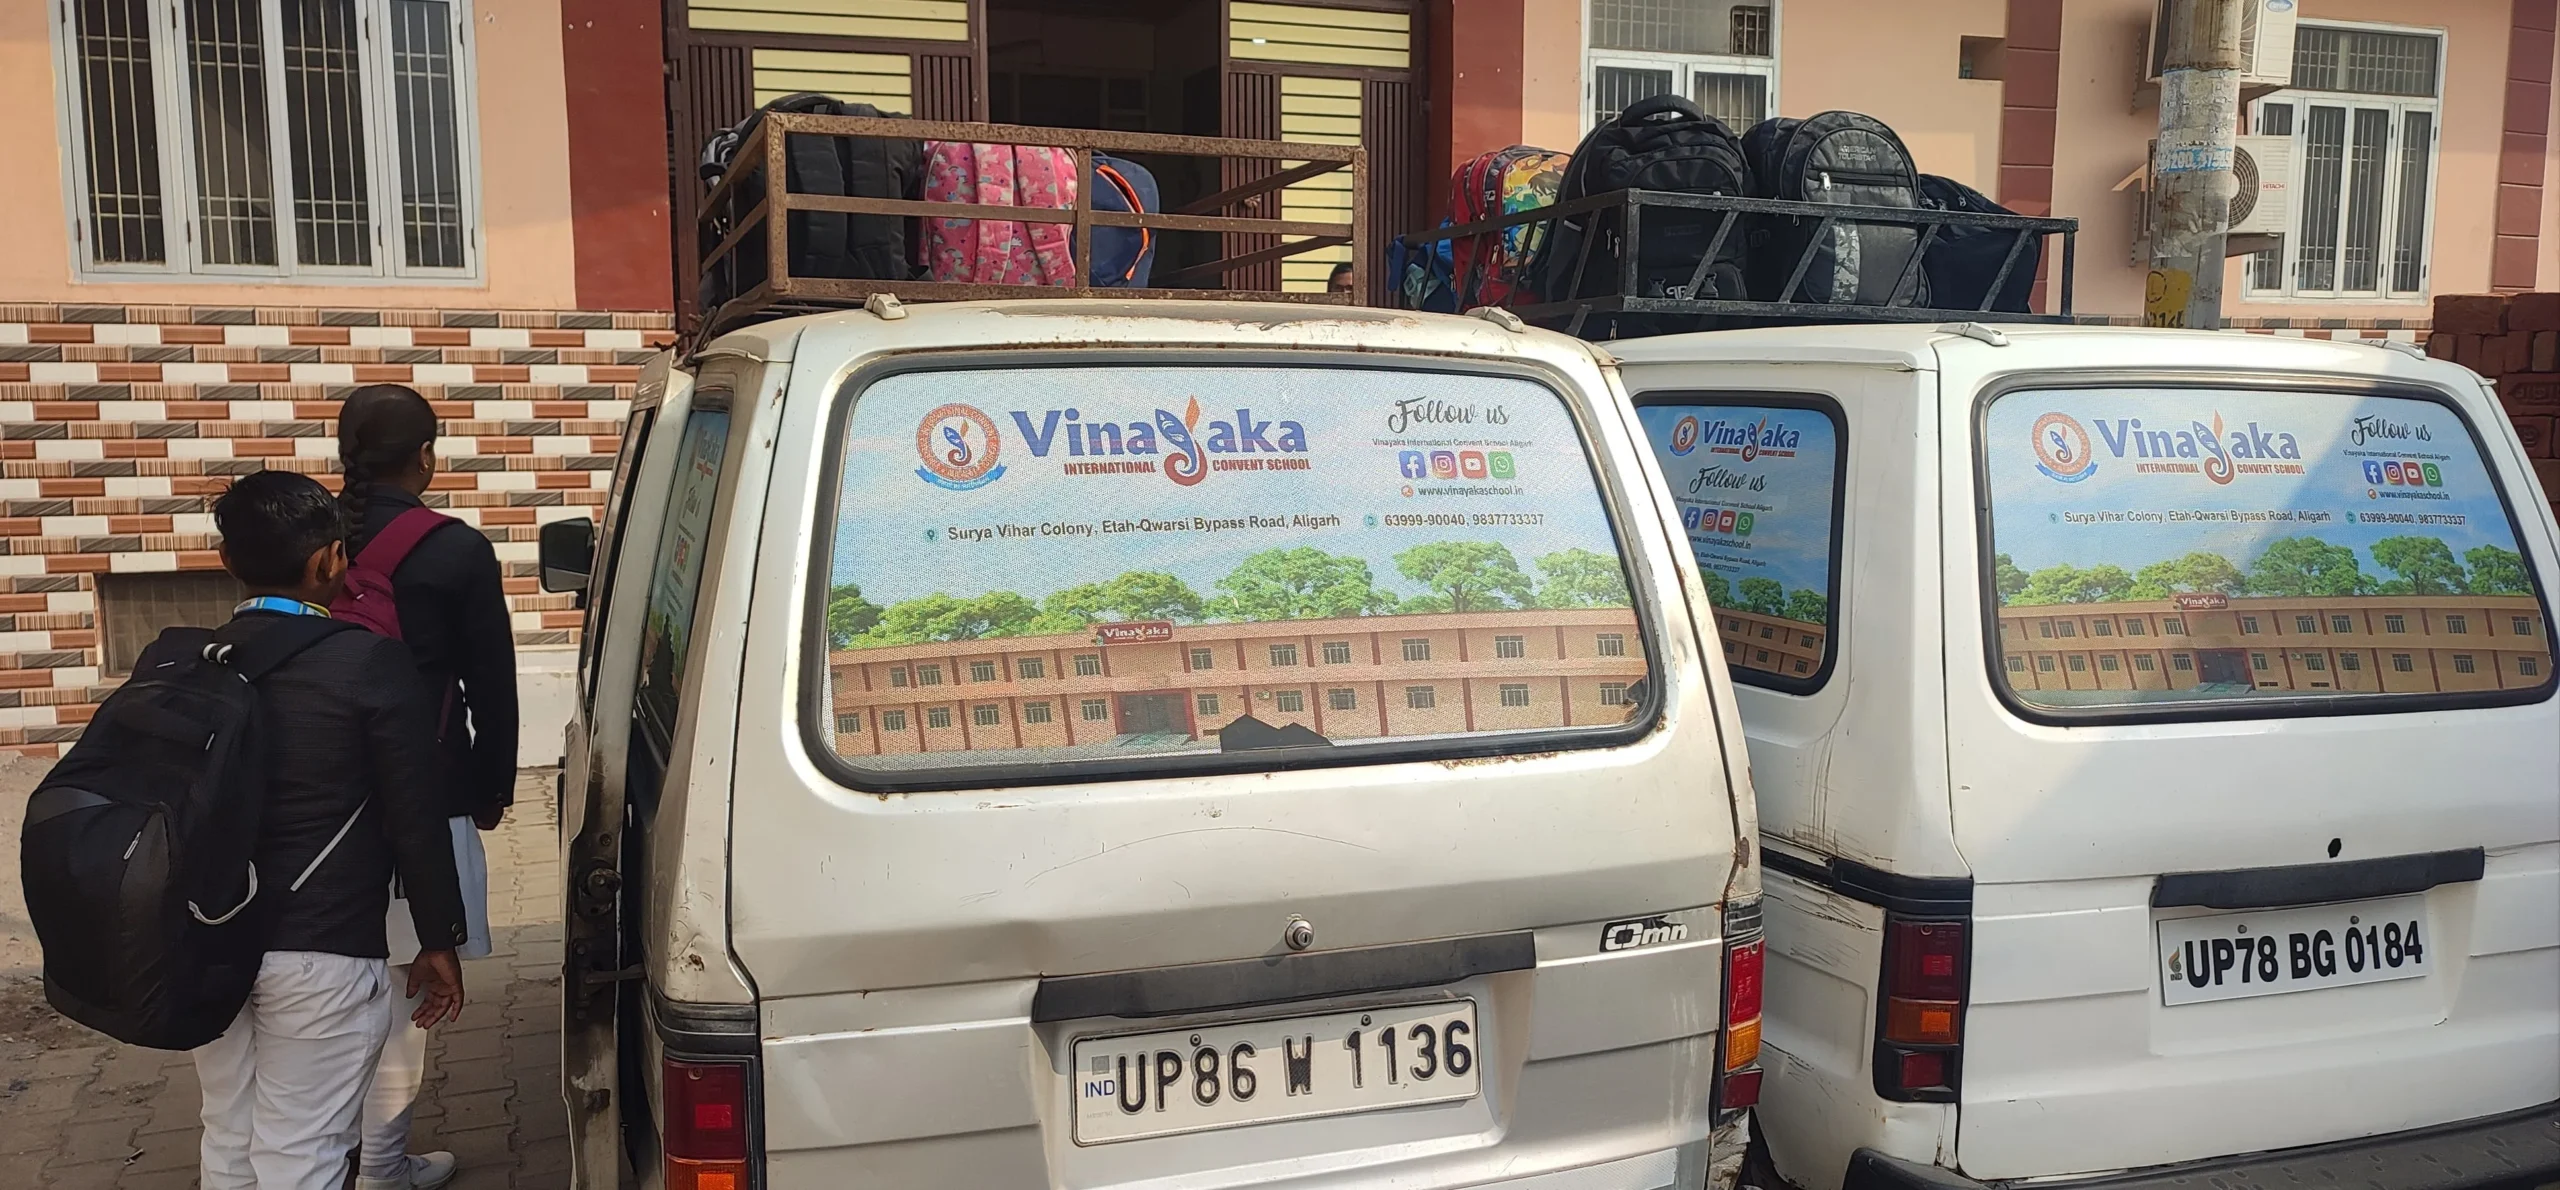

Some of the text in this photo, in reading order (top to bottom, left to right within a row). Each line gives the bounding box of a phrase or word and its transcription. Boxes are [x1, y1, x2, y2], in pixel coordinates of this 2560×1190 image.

[1388, 395, 1510, 433] Follow us
[1009, 394, 1308, 486] Vinayaka
[1704, 416, 1800, 461] Vinayaka
[2351, 414, 2432, 446] Follow us
[2093, 409, 2301, 485] Vinayaka
[1064, 458, 1312, 475] INTERNATIONAL CONVENT SCHOOL
[1689, 465, 1767, 493] Follow us
[2136, 463, 2305, 474] INTERNATIONAL CONVENT SCHOOL
[1418, 485, 1524, 497] www.vinayakaschool.in
[948, 514, 1340, 541] Surya Vihar Colony, Etah-Qwarsi Bypass Road, Aligarh
[1385, 513, 1544, 527] 63999-90040, 9837733337
[2064, 510, 2331, 523] Surya Vihar Colony, Etah-Qwarsi Bypass Road, Aligarh
[2360, 512, 2466, 525] 63999-90040, 9837733337
[2185, 920, 2423, 988] UP78 BG 0184
[2170, 973, 2183, 981] IND
[1117, 1019, 1472, 1113] UP86 W 1136
[1085, 1080, 1115, 1098] IND
